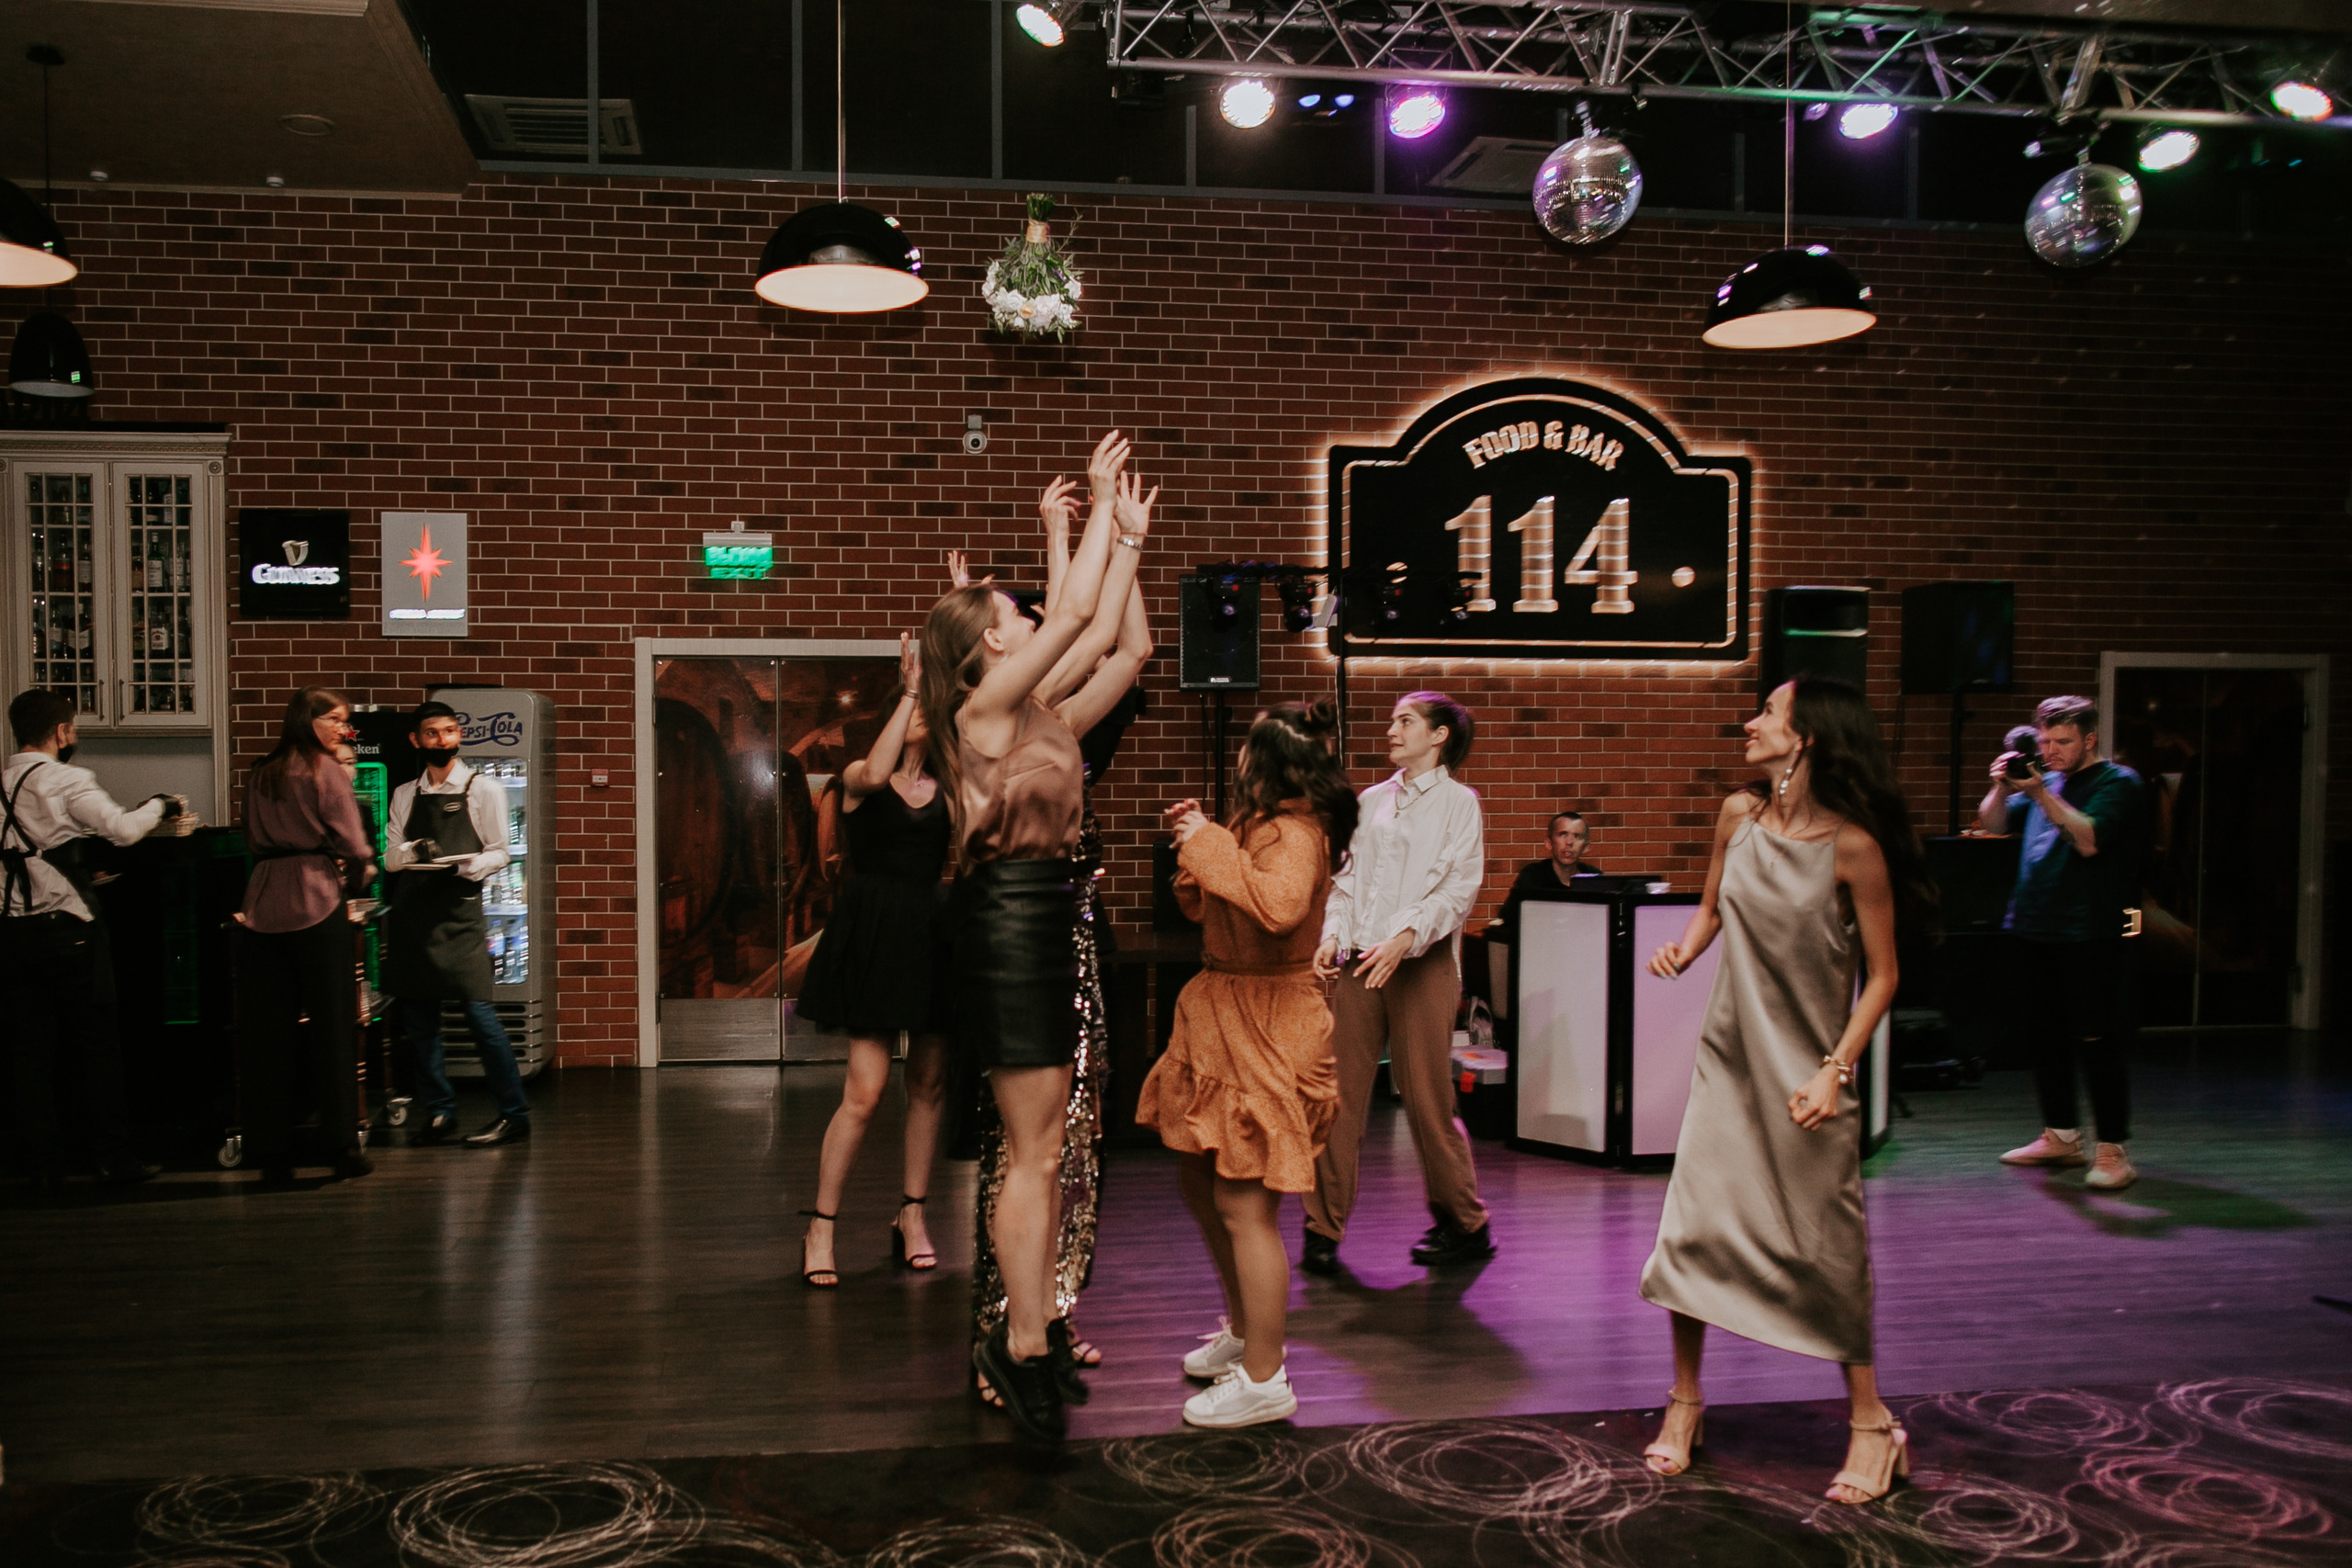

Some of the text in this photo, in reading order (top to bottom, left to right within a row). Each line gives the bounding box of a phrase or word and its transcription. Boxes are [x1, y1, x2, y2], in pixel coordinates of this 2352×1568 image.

[1463, 420, 1624, 471] FOOD & BAR
[1445, 495, 1638, 615] 114
